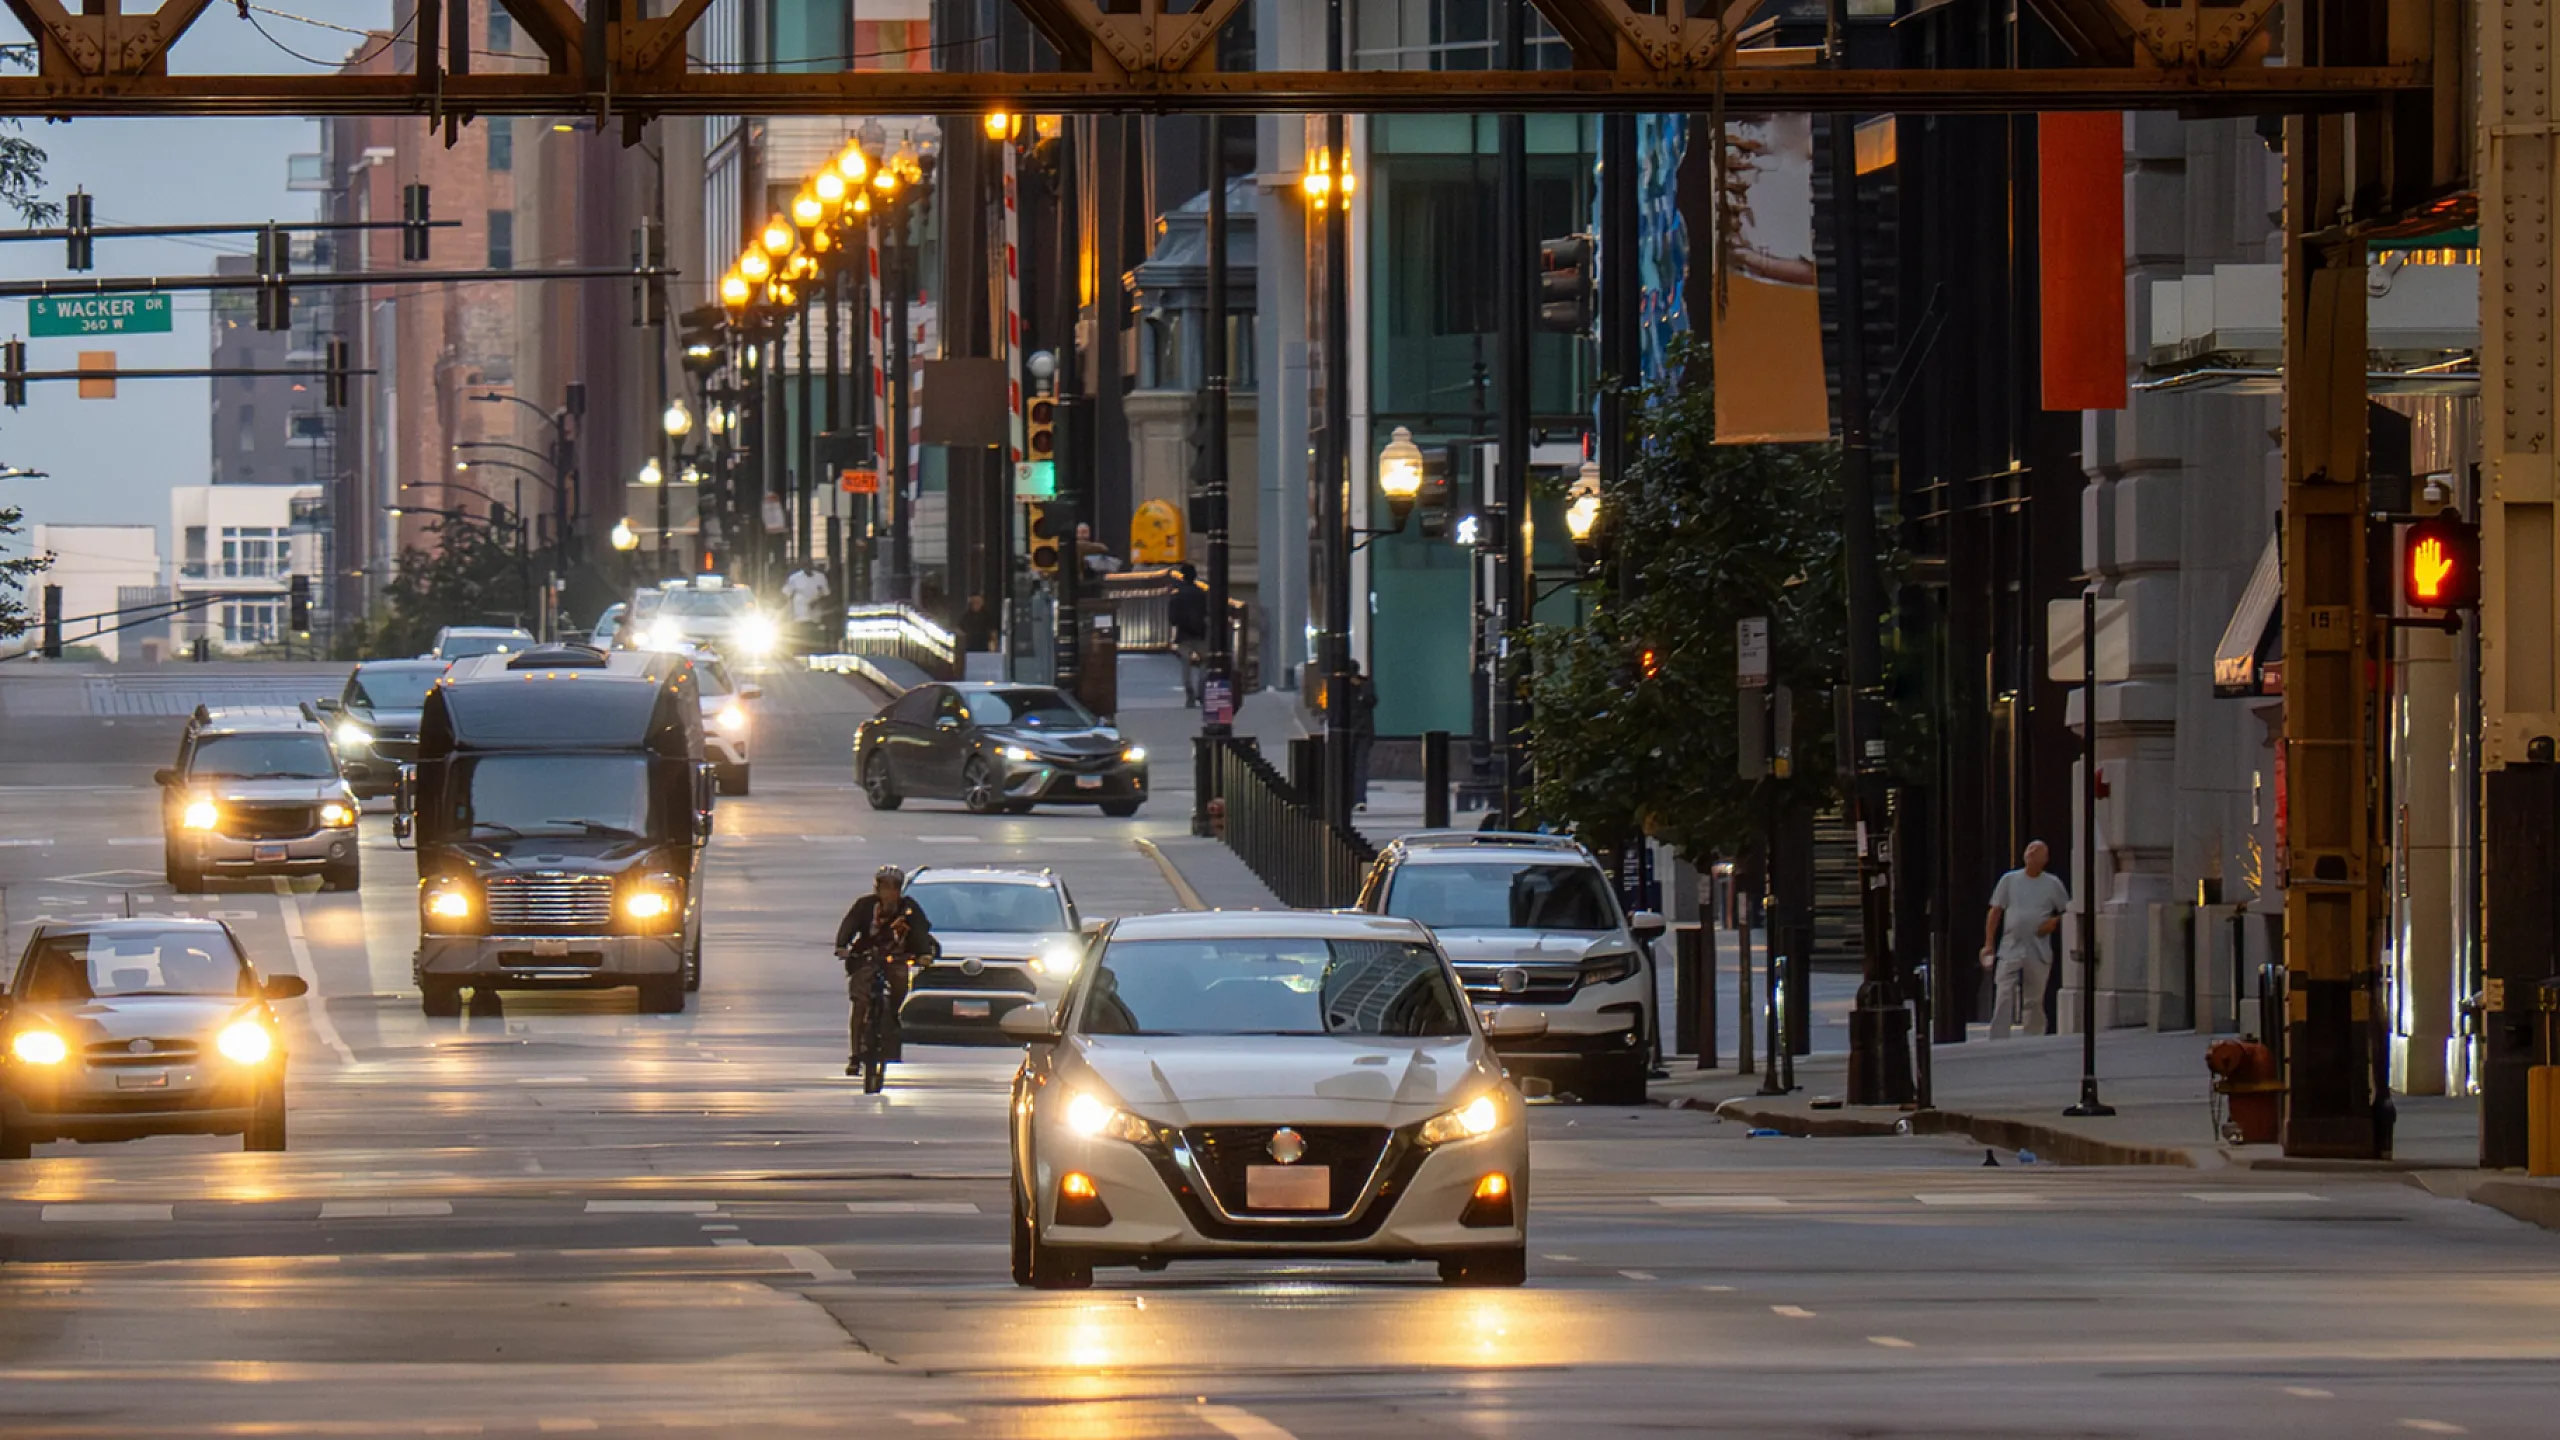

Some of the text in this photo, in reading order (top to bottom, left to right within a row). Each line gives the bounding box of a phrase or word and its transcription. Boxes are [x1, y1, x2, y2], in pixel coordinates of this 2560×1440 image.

[37, 298, 163, 318] S WACKER DR
[81, 318, 124, 331] 360 W
